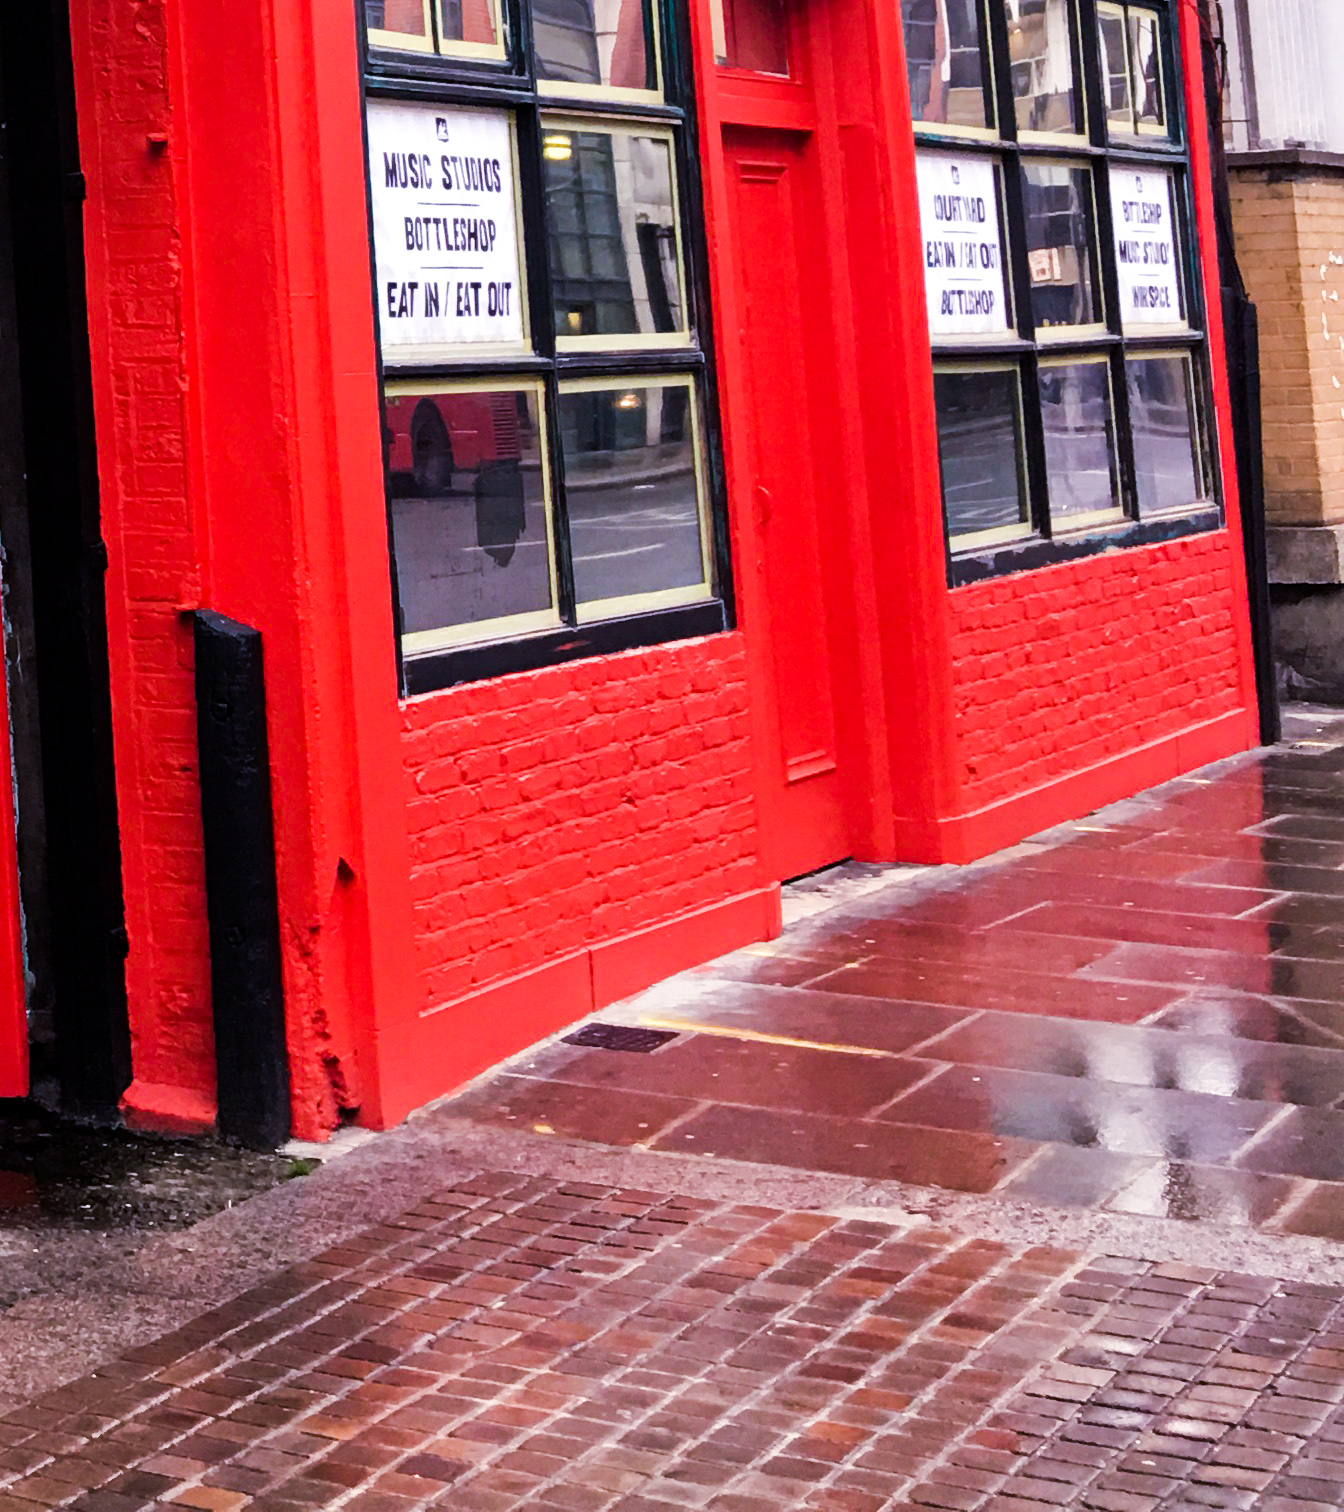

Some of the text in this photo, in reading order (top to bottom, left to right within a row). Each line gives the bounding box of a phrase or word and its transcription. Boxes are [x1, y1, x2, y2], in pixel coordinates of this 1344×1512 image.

[383, 152, 501, 193] MUSIC STUDIOS
[404, 217, 496, 252] BOTTLESHOP
[927, 241, 943, 268] EAT
[387, 282, 511, 318] EAT IN / EAT OUT
[1132, 286, 1170, 308] WRKSPCE
